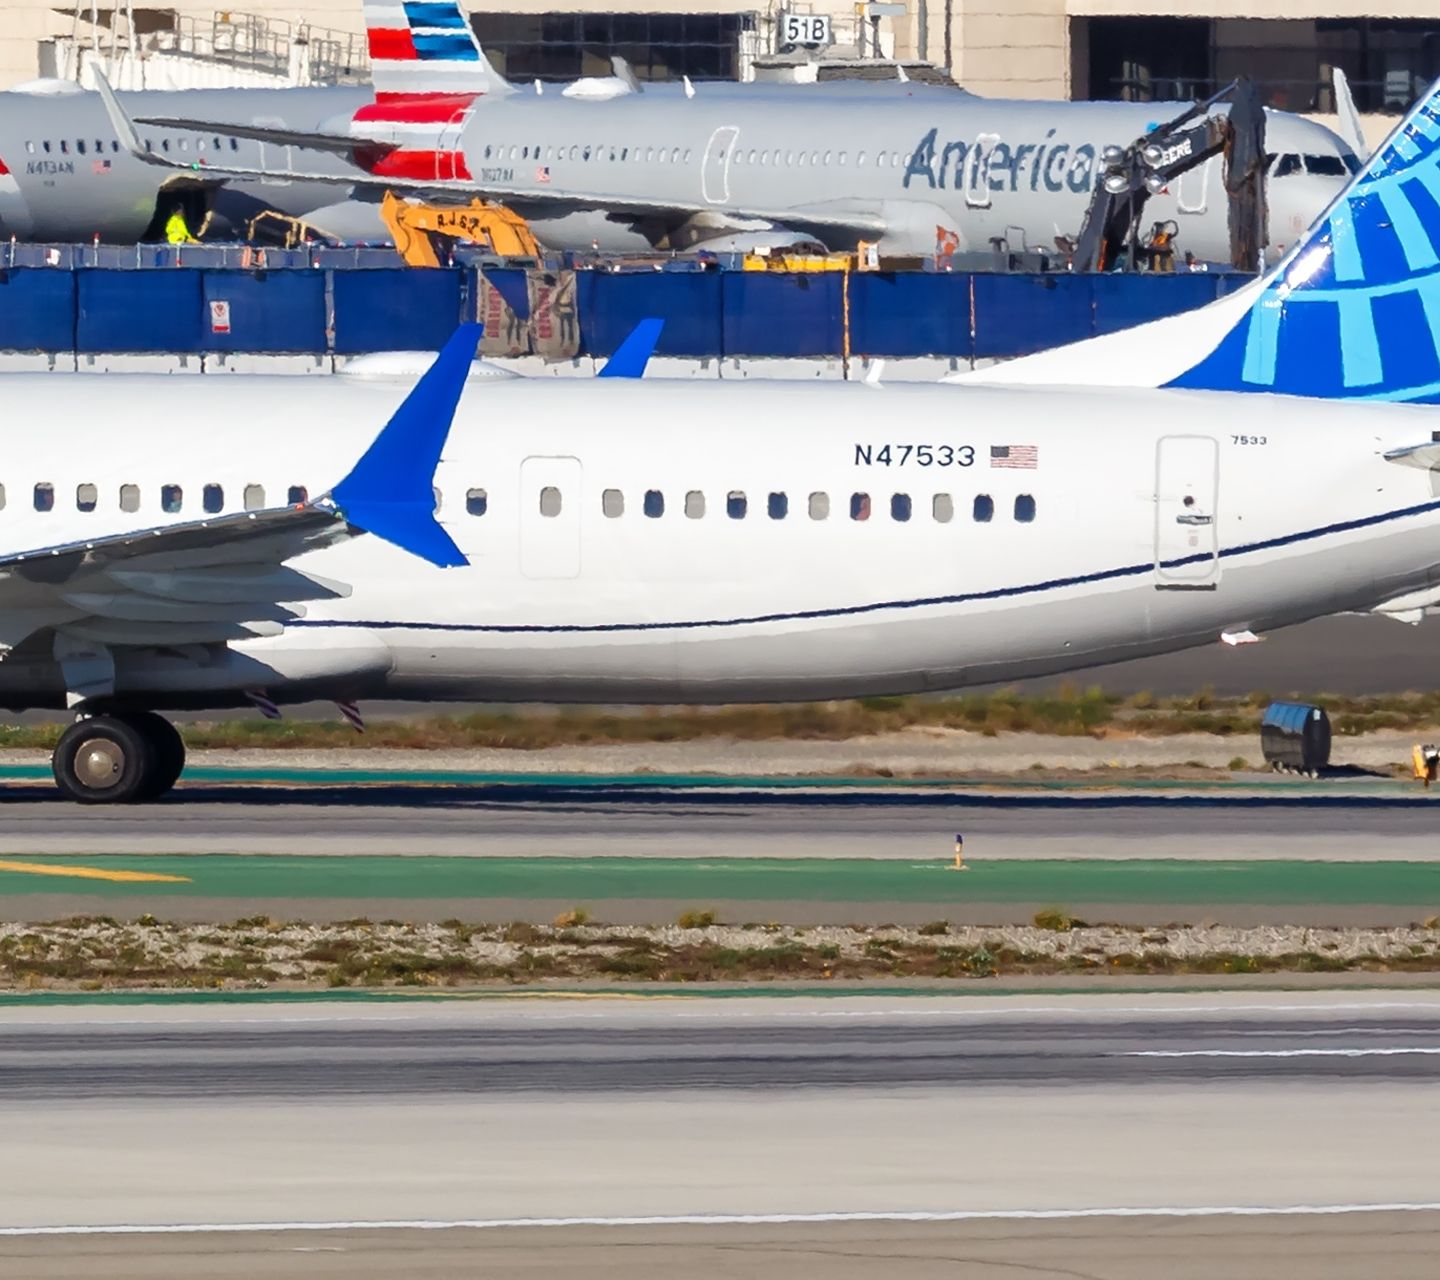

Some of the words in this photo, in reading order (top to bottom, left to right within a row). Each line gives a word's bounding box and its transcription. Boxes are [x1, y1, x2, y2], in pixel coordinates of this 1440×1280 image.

[787, 17, 825, 41] 51B
[902, 127, 1106, 194] America
[1153, 138, 1192, 170] EERE
[1230, 434, 1268, 446] 7533
[853, 444, 975, 467] N47533
